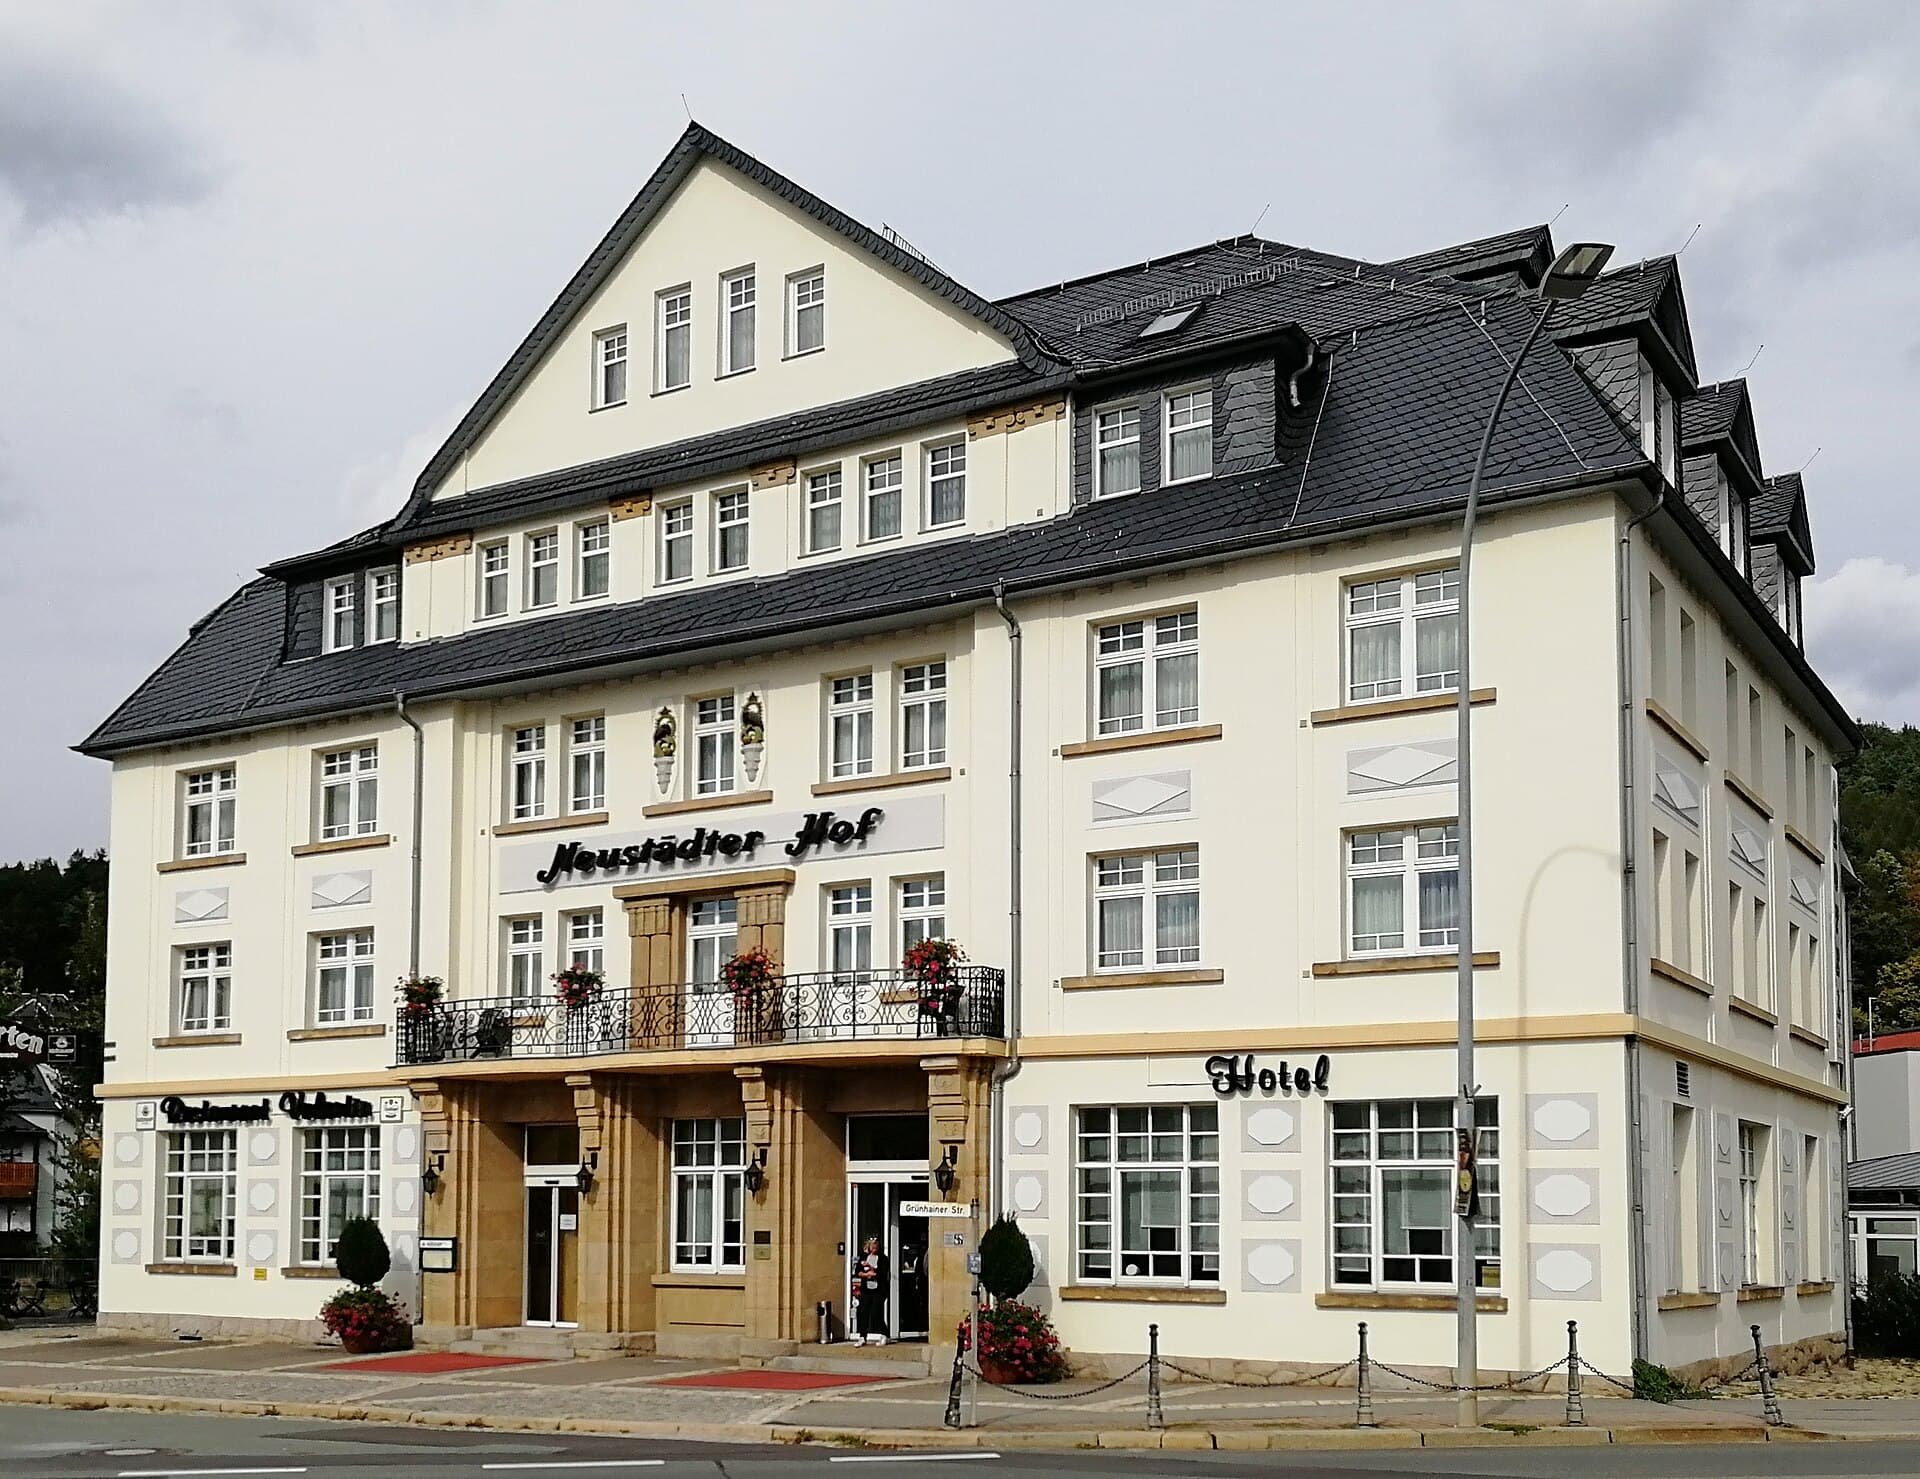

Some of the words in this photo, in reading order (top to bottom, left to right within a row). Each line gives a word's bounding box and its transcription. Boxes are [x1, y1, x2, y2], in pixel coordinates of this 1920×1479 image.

[536, 827, 764, 884] Neustädter
[785, 807, 883, 857] Hof
[1205, 1054, 1330, 1094] Hotel
[951, 1205, 966, 1215] Str.
